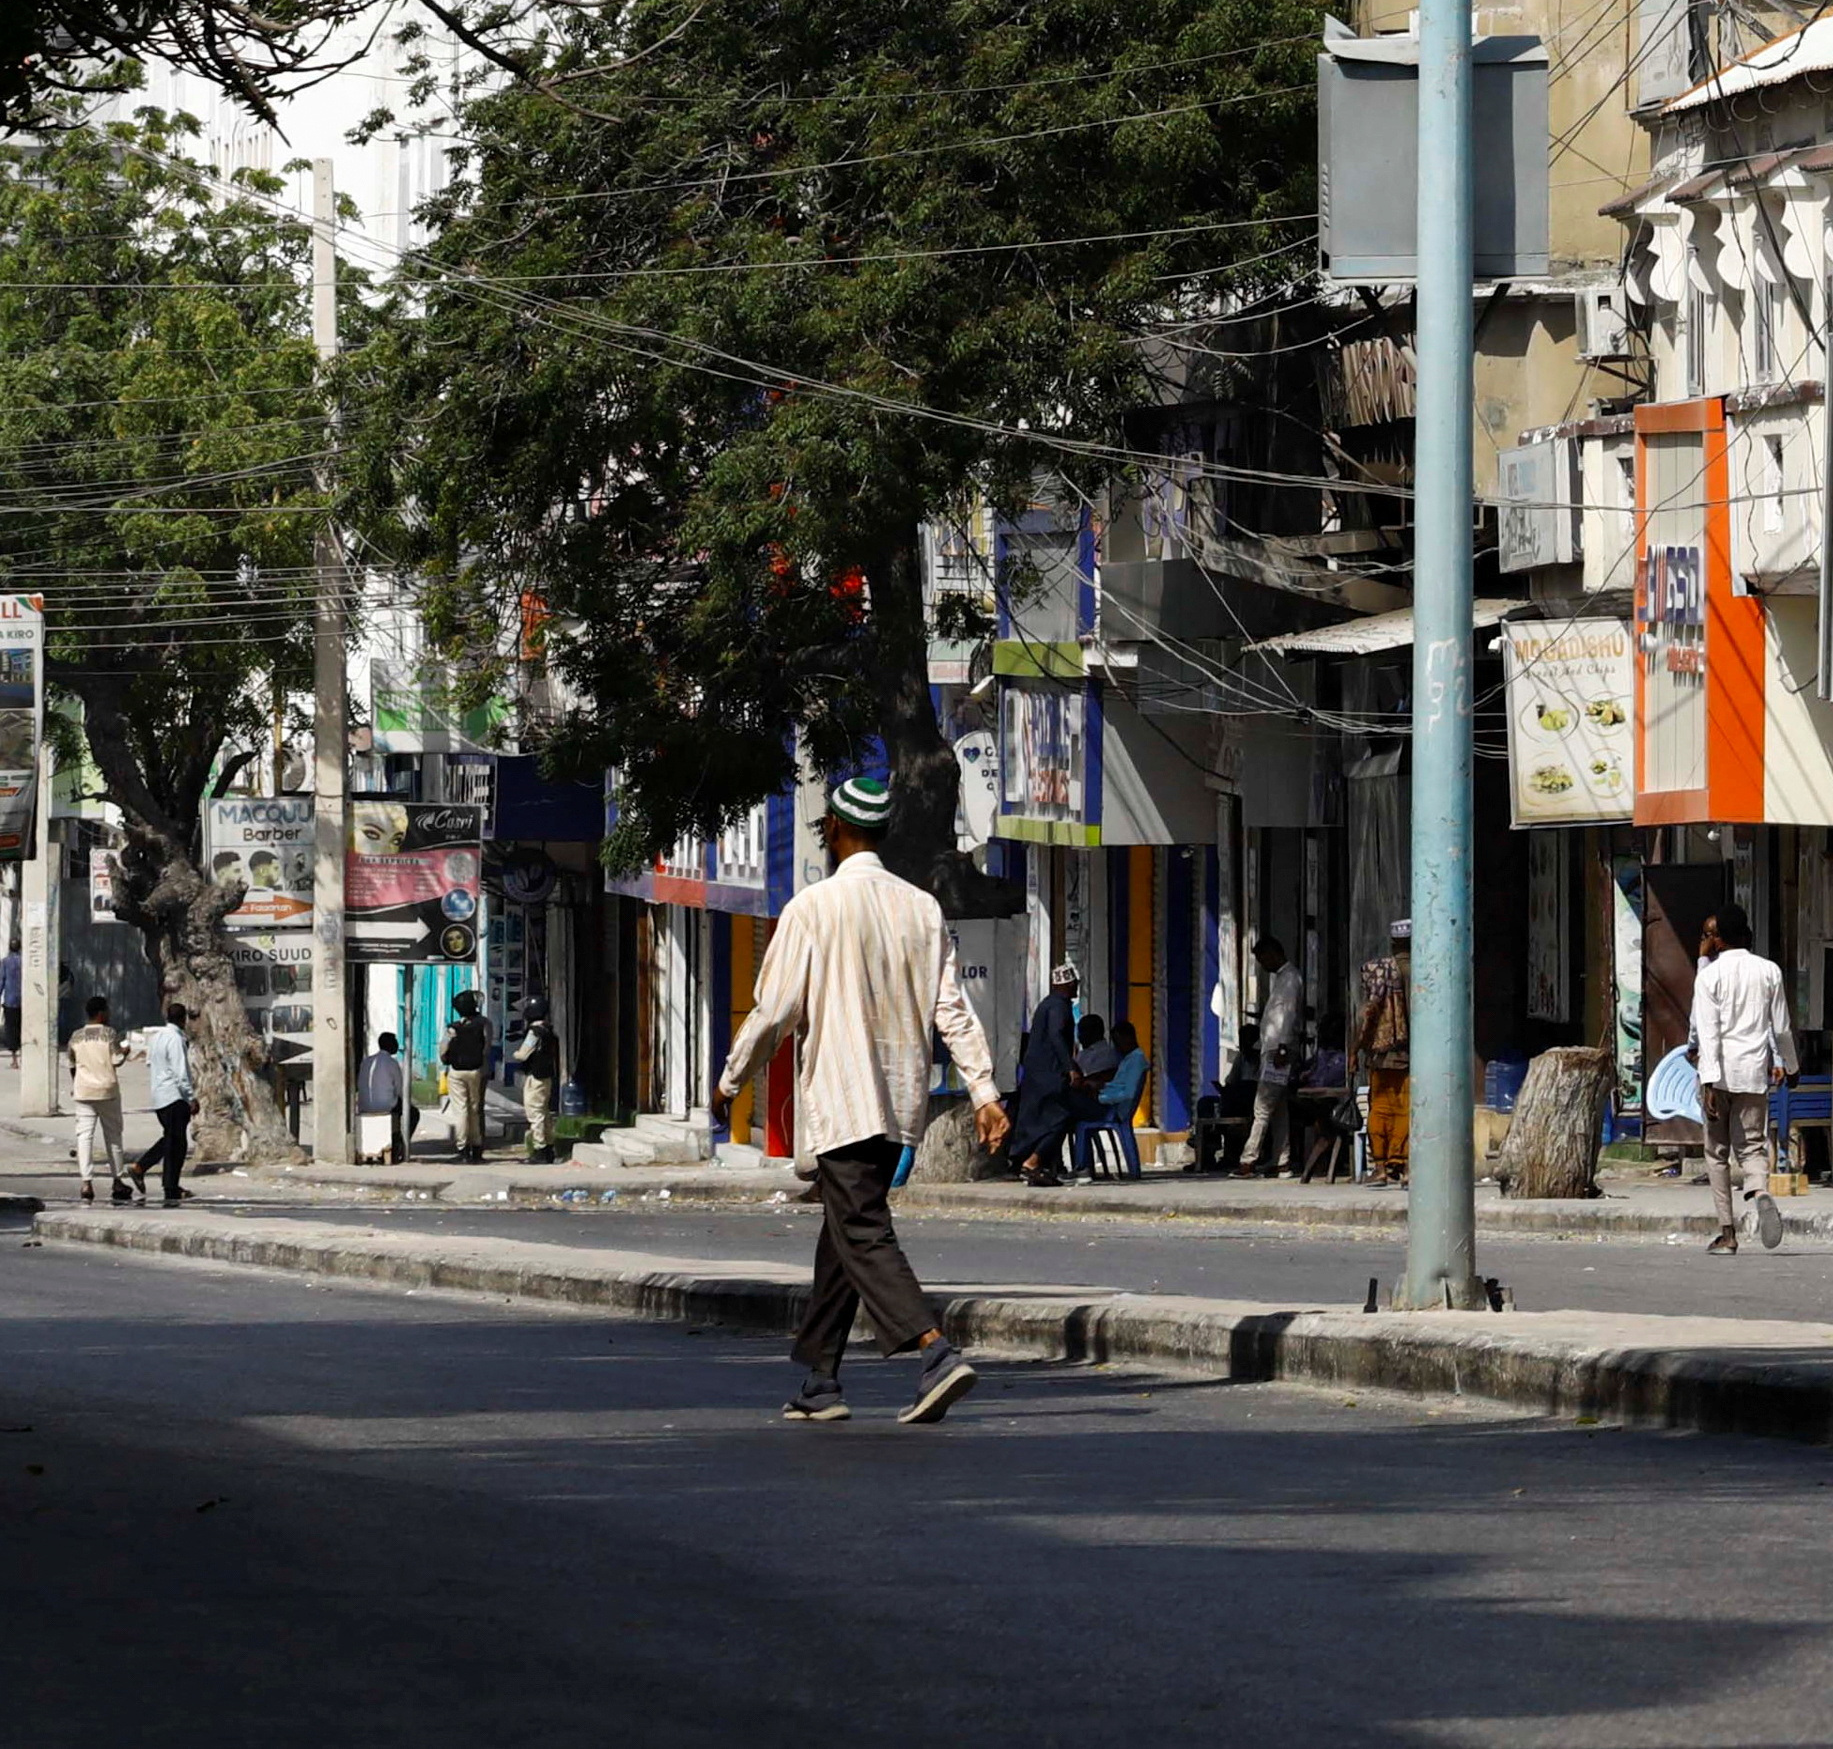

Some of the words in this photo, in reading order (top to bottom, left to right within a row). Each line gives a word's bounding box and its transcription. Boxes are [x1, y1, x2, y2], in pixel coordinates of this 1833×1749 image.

[1514, 633, 1625, 664] MOGADISHU
[243, 828, 302, 842] Barber
[269, 948, 312, 961] SUUD
